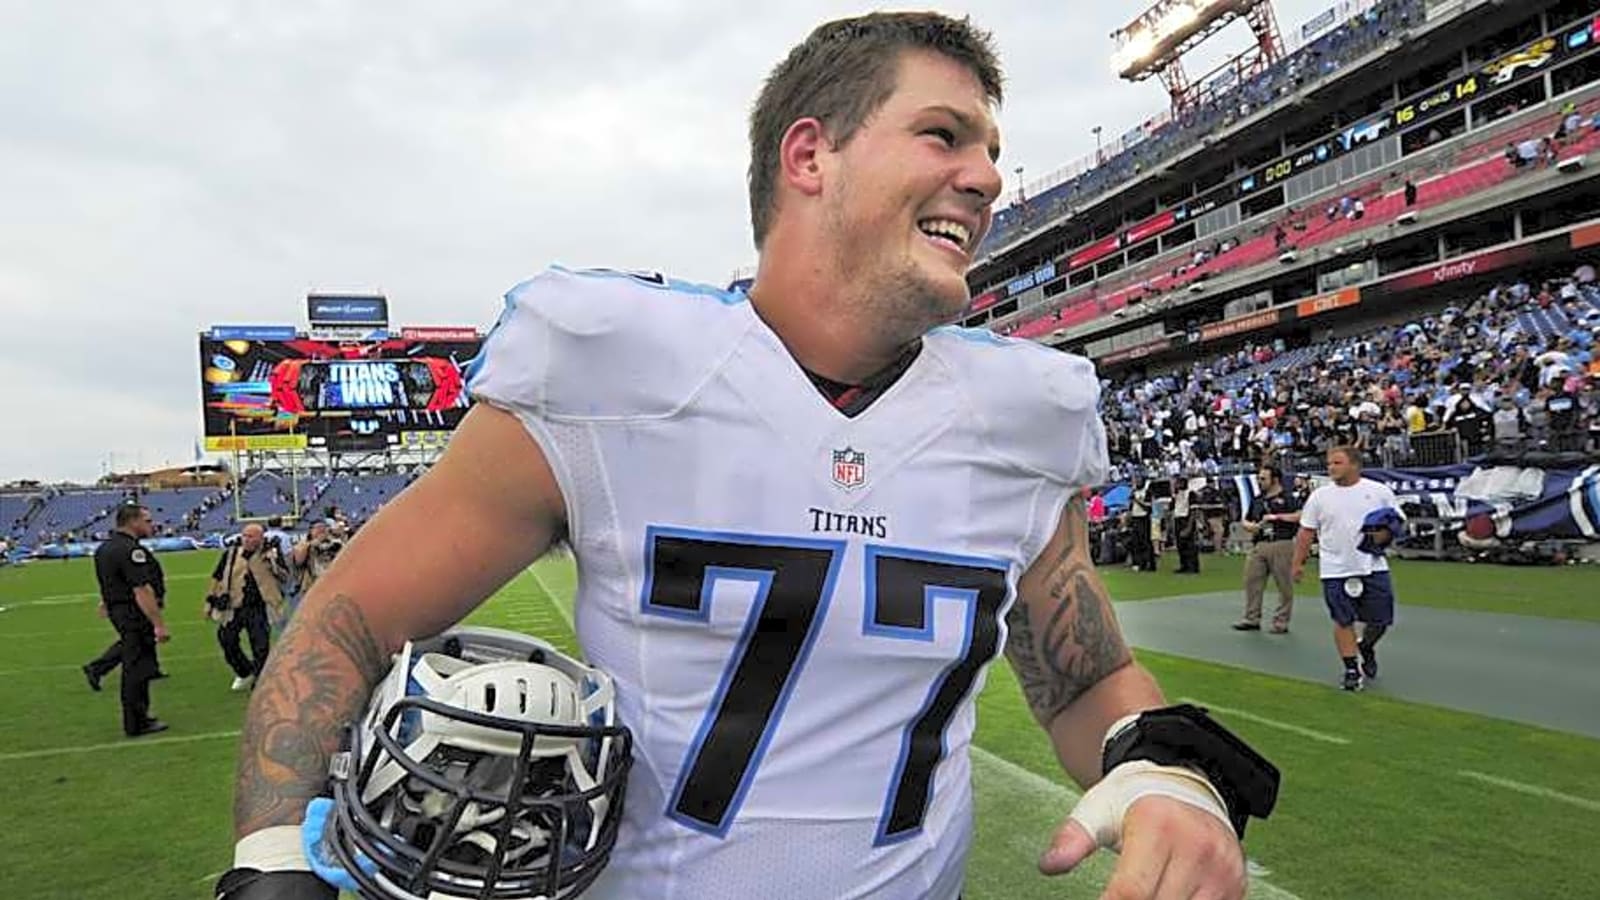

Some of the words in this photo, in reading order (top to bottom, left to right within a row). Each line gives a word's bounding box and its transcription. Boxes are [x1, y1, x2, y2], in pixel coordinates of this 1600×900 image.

[1456, 78, 1477, 98] 14
[1396, 105, 1415, 124] 16
[1432, 261, 1476, 281] xfinity
[328, 362, 399, 383] TITANS
[340, 380, 394, 404] WIN
[837, 463, 861, 484] NFL
[810, 507, 886, 538] TITANS
[641, 525, 1012, 848] 77
